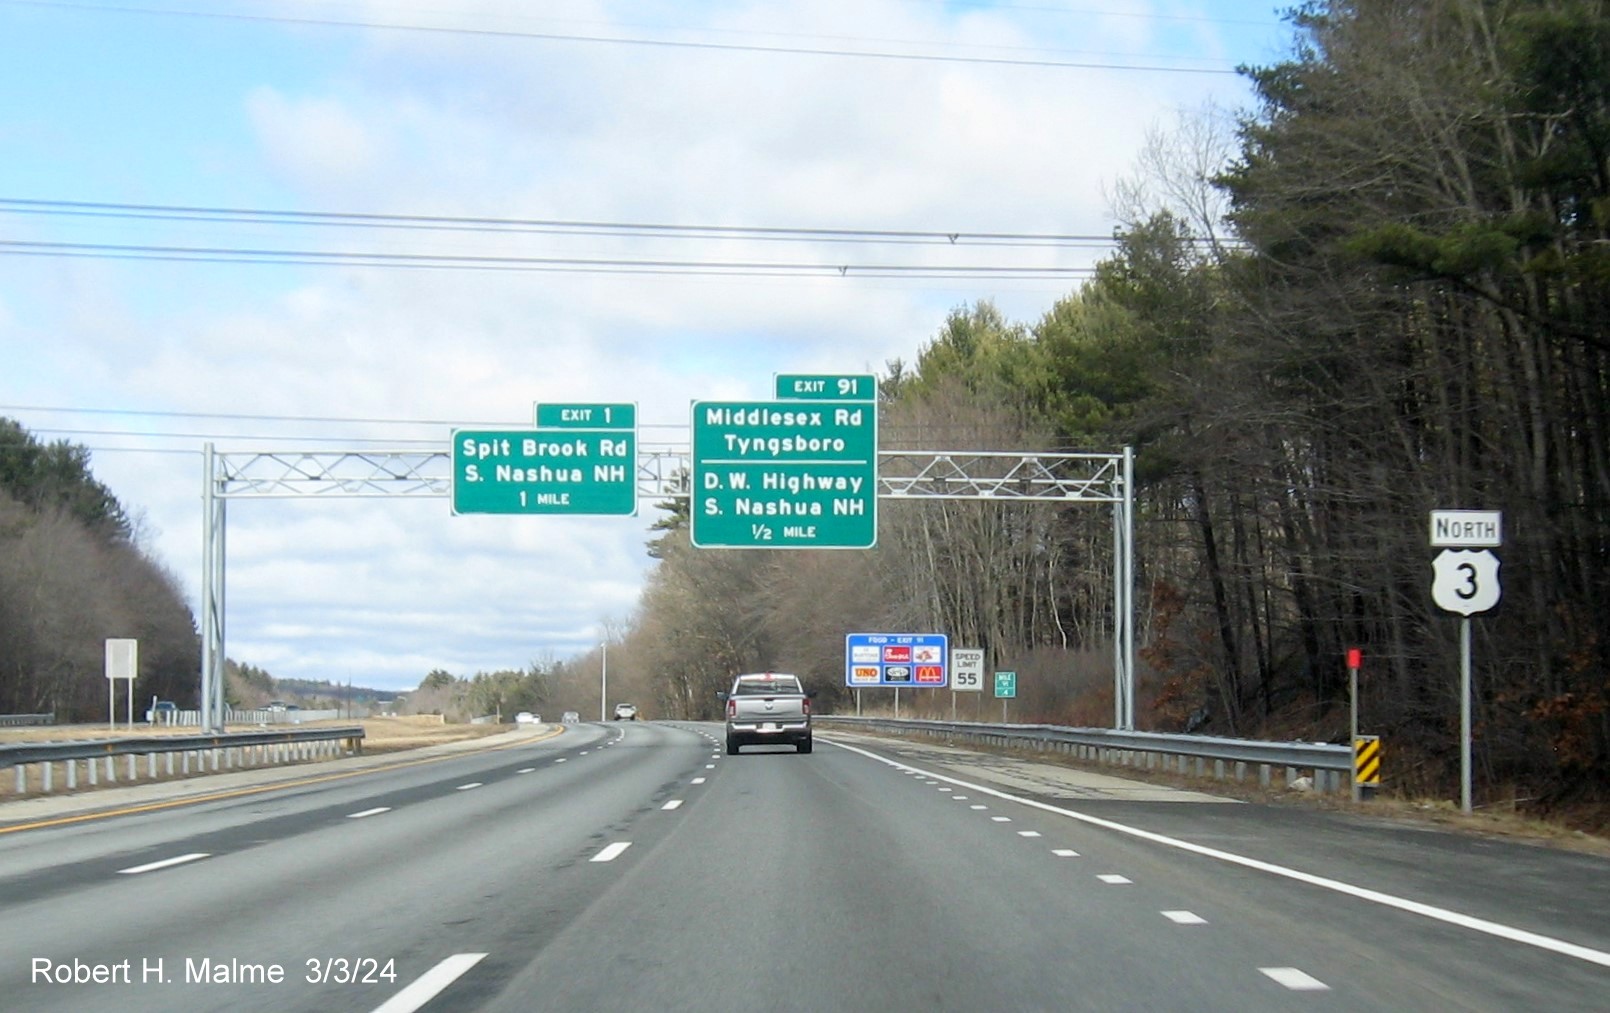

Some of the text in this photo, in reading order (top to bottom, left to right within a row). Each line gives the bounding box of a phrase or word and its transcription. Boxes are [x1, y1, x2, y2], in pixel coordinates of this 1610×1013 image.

[794, 379, 858, 395] EXIT 91
[561, 407, 611, 424] EXIT 1
[706, 408, 862, 426] Middlesex Rd
[463, 439, 627, 460] Spit Brook Rd
[724, 434, 845, 456] Tyngsboro
[465, 465, 625, 482] S. Nashua NH
[762, 473, 863, 495] Highway
[519, 490, 570, 507] 1 MILE
[705, 498, 864, 516] S. Nashua NH
[783, 526, 816, 538] MILE
[1437, 518, 1496, 538] NORTH
[1455, 562, 1478, 600] 3
[855, 668, 878, 677] UNO
[957, 672, 977, 685] 55
